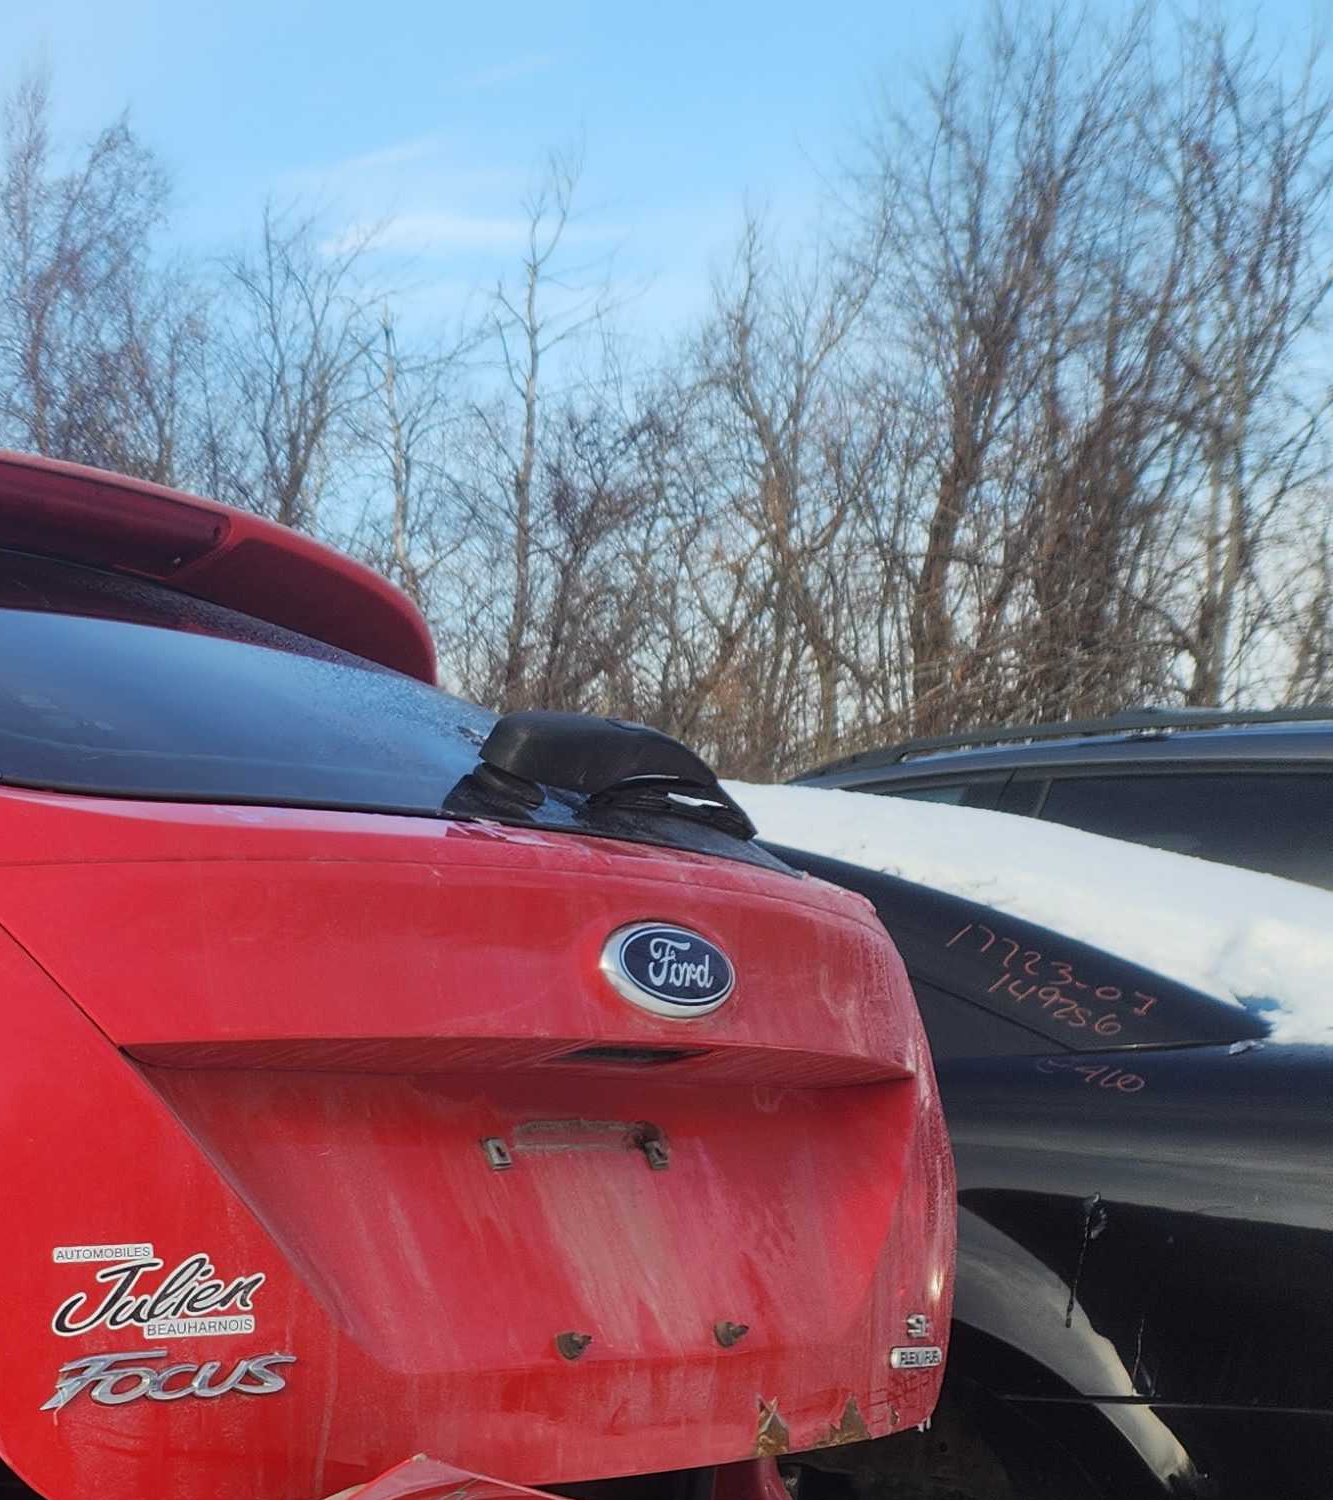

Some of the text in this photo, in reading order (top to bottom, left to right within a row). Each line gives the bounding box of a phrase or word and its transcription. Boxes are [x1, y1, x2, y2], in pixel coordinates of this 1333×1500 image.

[648, 937, 714, 989] Ford
[54, 1246, 152, 1262] AUTOMOBILES
[54, 1256, 265, 1334] Julien
[146, 1317, 255, 1337] BEAUHARNOIS
